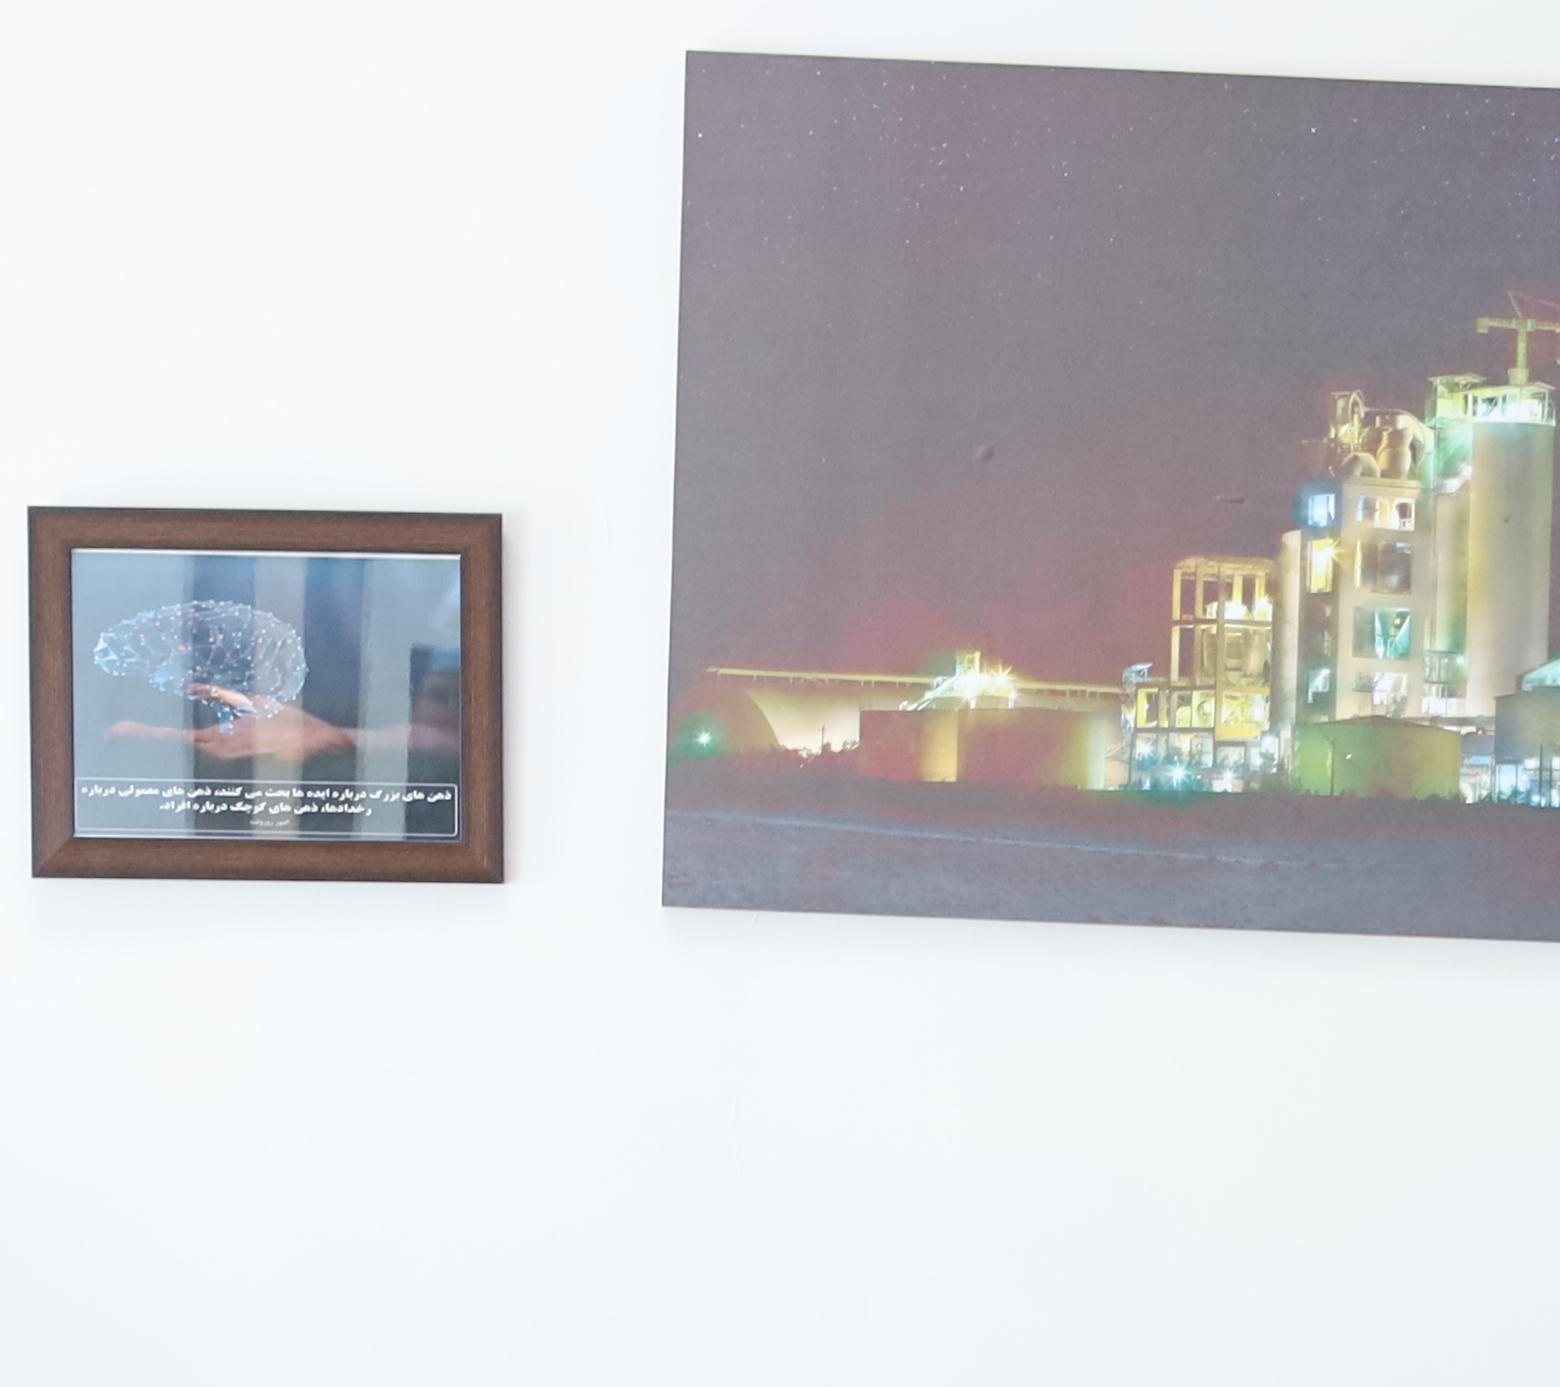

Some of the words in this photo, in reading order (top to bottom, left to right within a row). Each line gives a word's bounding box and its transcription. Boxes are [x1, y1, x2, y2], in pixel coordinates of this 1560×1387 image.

[81, 784, 116, 797] درباره
[117, 785, 160, 797] معمولی
[162, 786, 185, 798] های
[187, 785, 212, 799] ذهن
[244, 790, 263, 799] می
[265, 788, 290, 799] بحث
[292, 787, 305, 797] ها
[306, 788, 330, 800] ایده
[332, 788, 367, 801] درباره
[369, 789, 400, 802] بزرگ
[402, 789, 425, 802] های
[427, 789, 452, 803] ذهن
[192, 800, 227, 814] درباره
[229, 801, 267, 815] کوچک
[268, 802, 292, 814] های
[293, 801, 319, 815] ذهن
